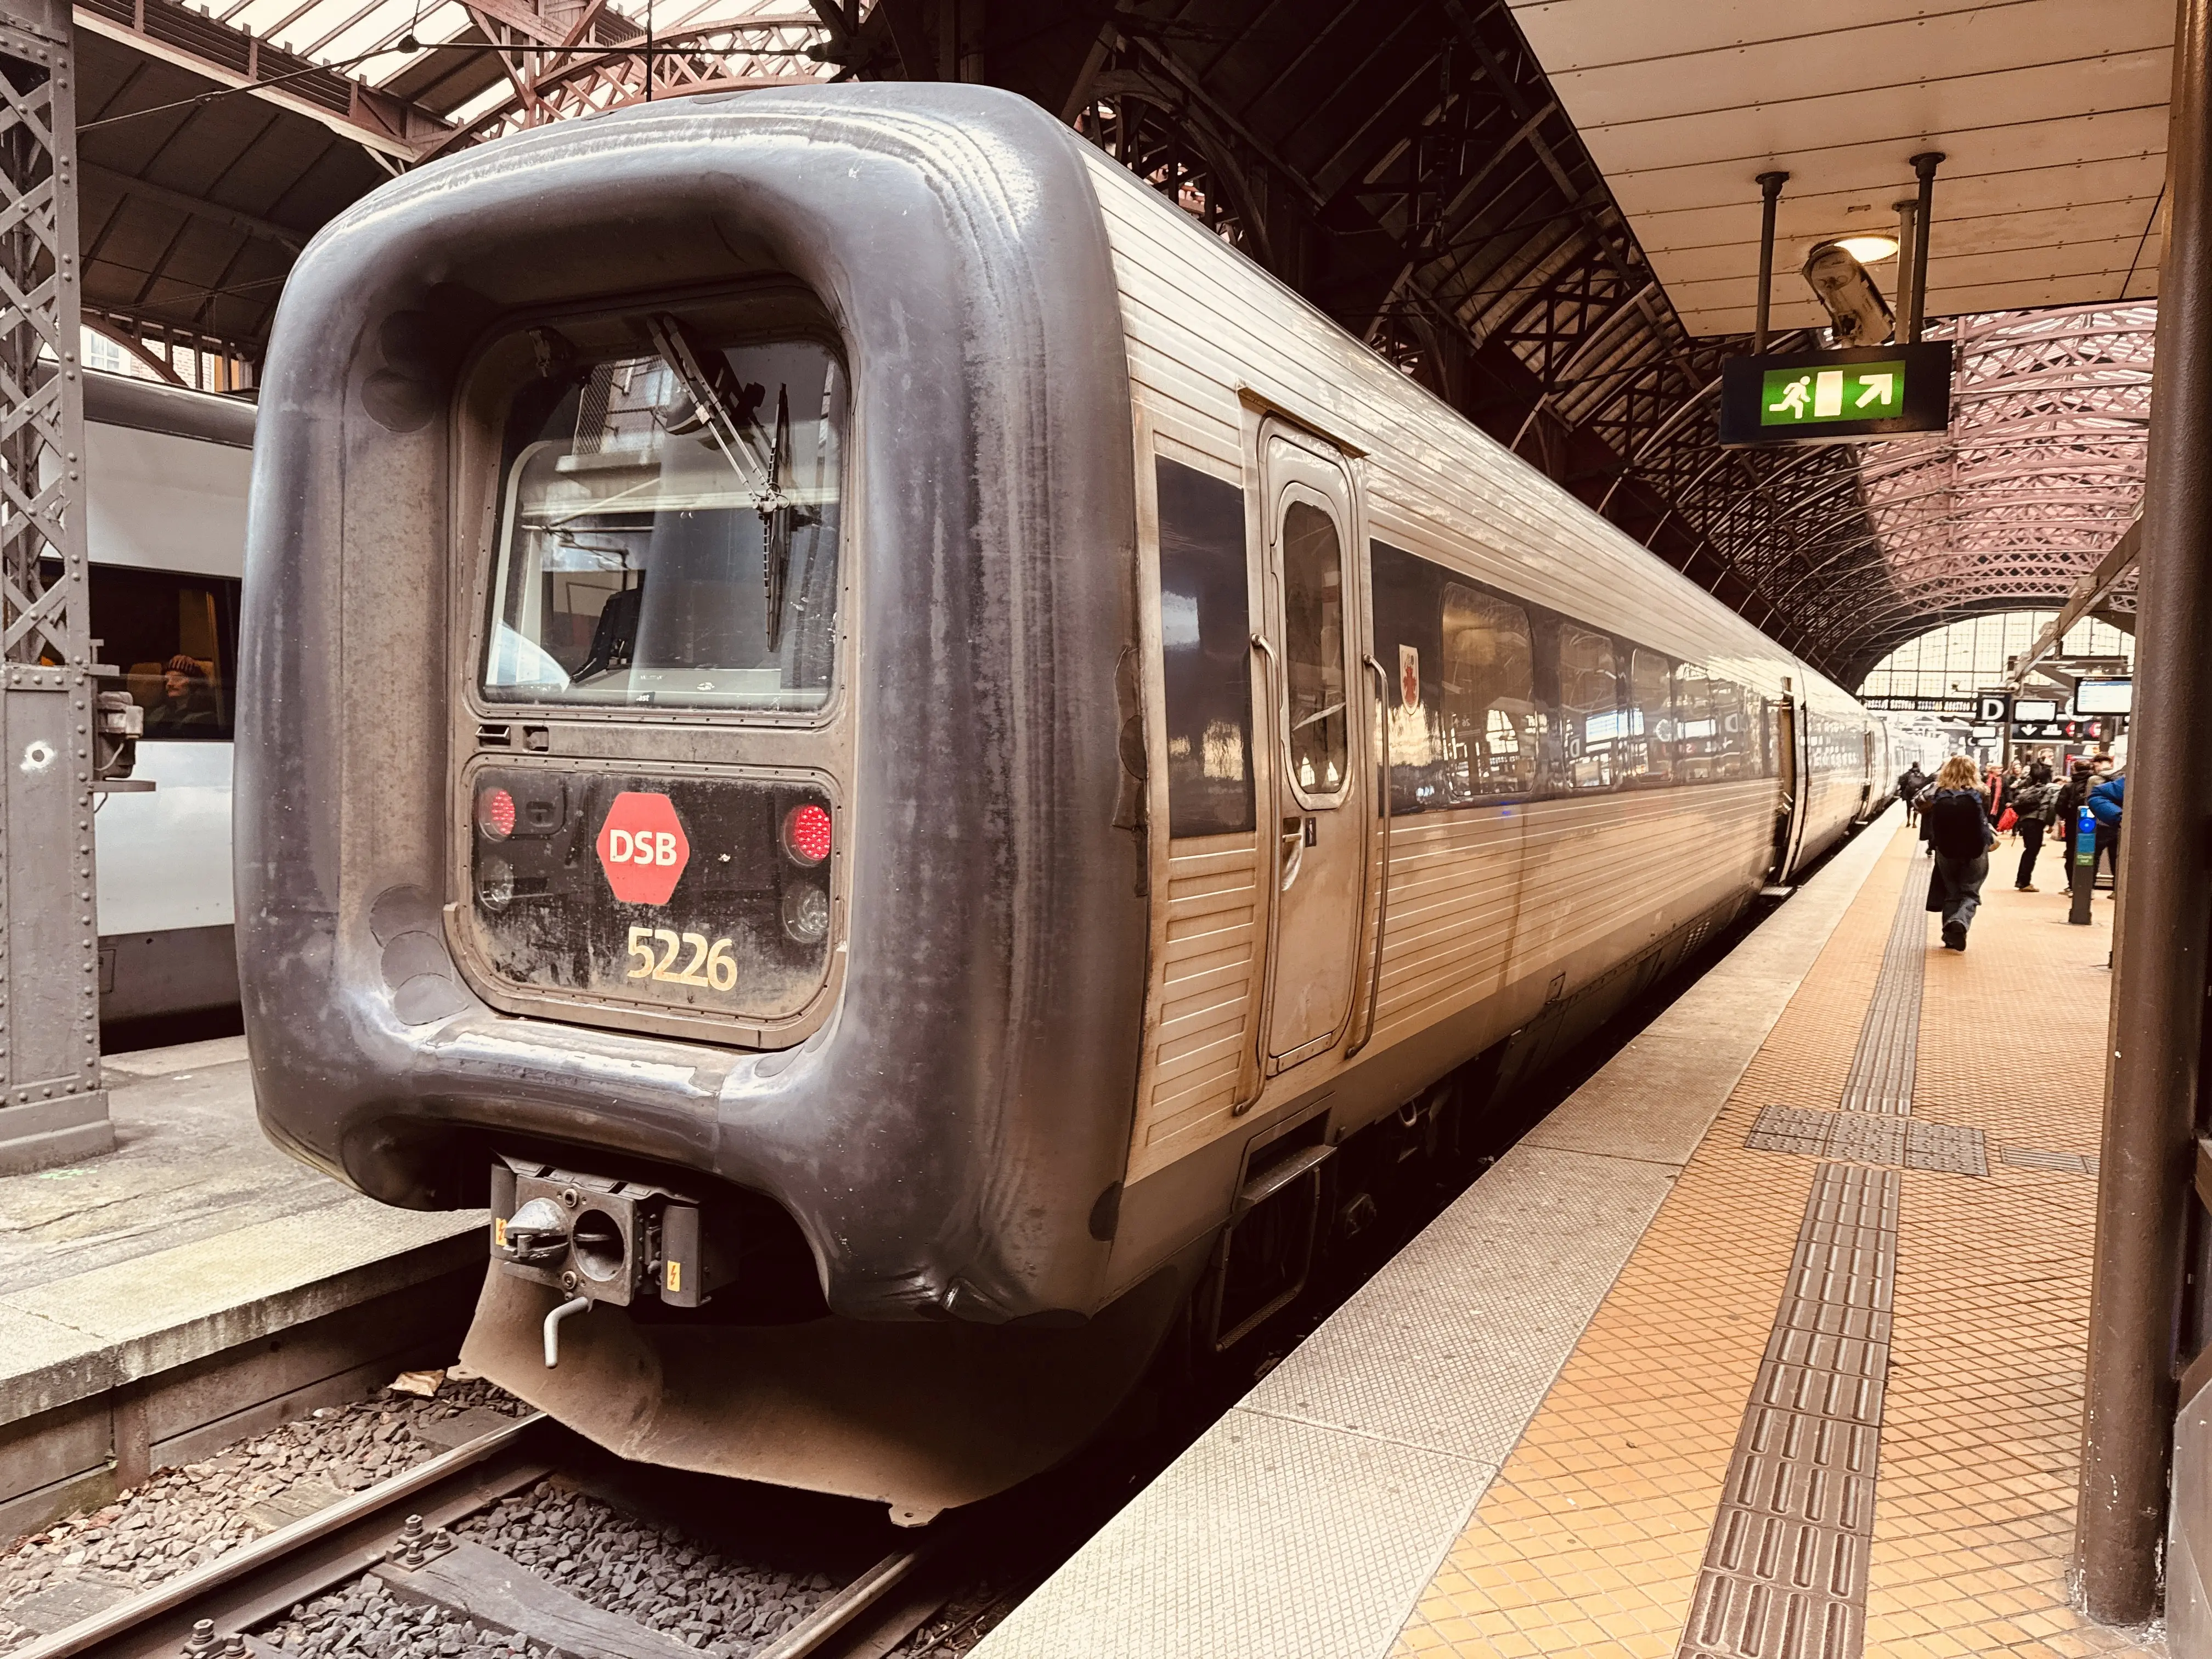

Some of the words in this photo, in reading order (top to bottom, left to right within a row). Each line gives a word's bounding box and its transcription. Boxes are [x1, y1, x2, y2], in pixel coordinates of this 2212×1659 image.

[1982, 699, 2005, 720] D
[610, 829, 677, 866] DSB
[627, 926, 737, 991] 5226
